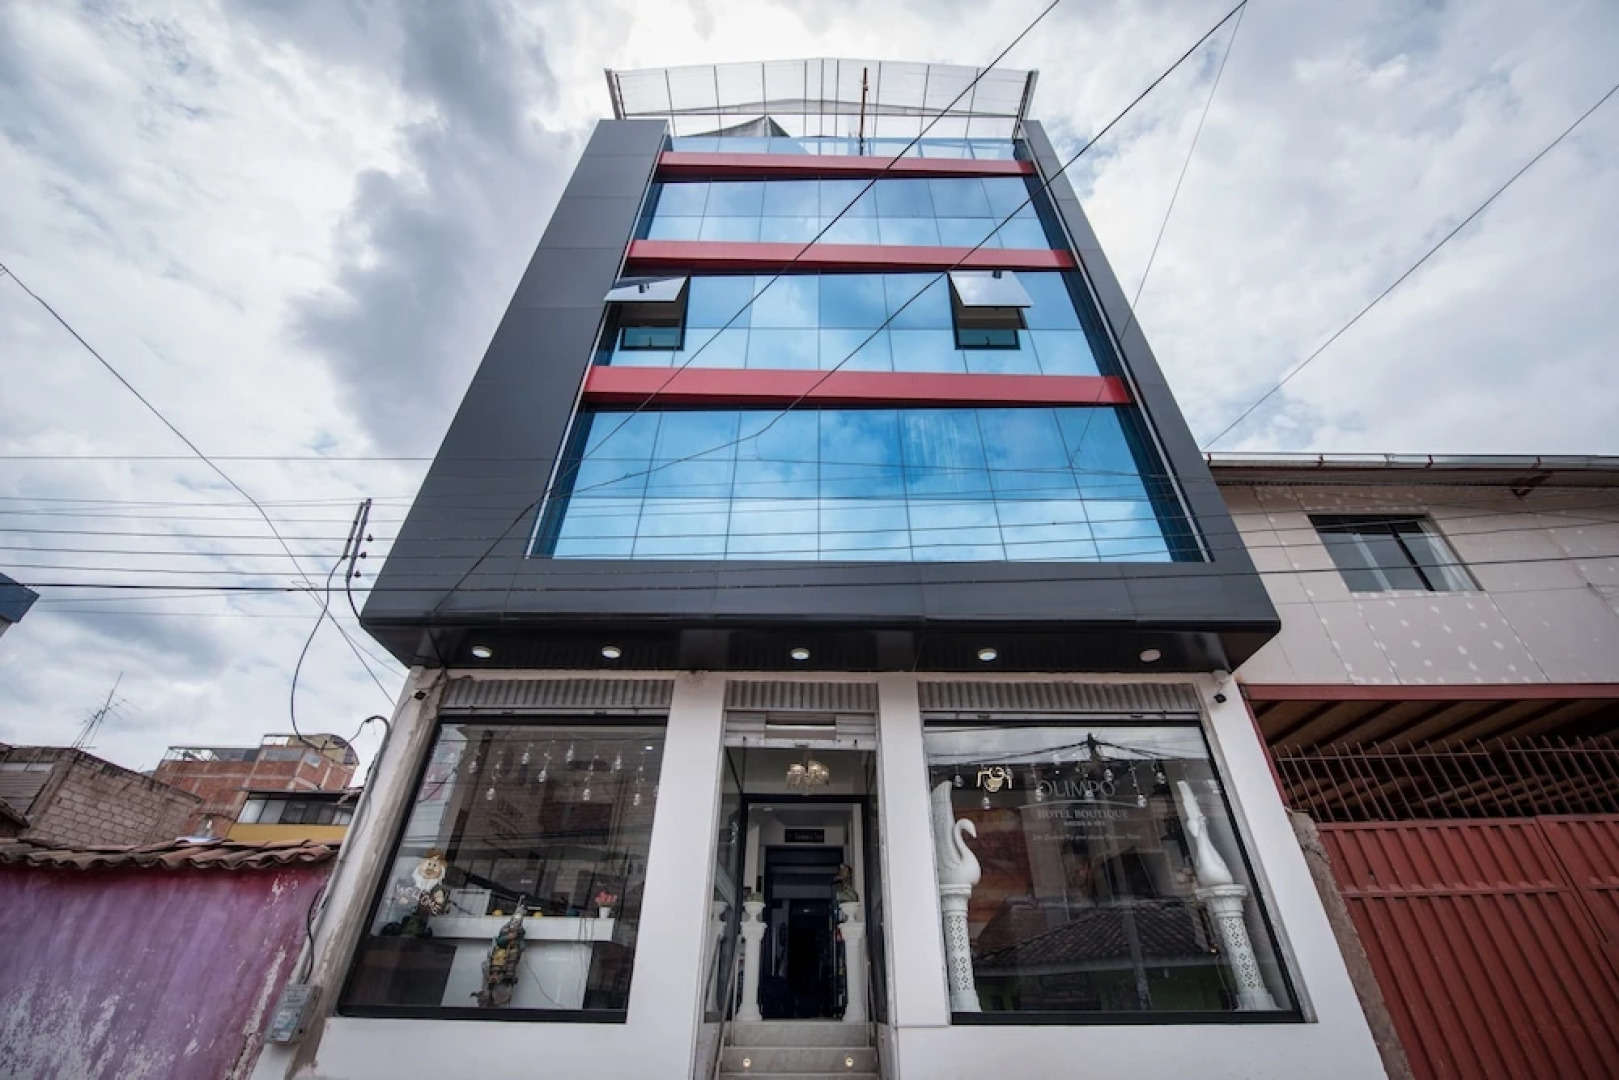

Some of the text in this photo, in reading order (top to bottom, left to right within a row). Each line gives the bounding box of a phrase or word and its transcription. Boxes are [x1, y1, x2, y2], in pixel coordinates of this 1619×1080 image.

[1037, 780, 1116, 797] OLIMPO
[1037, 809, 1128, 819] HOTEL BOUTIQUE
